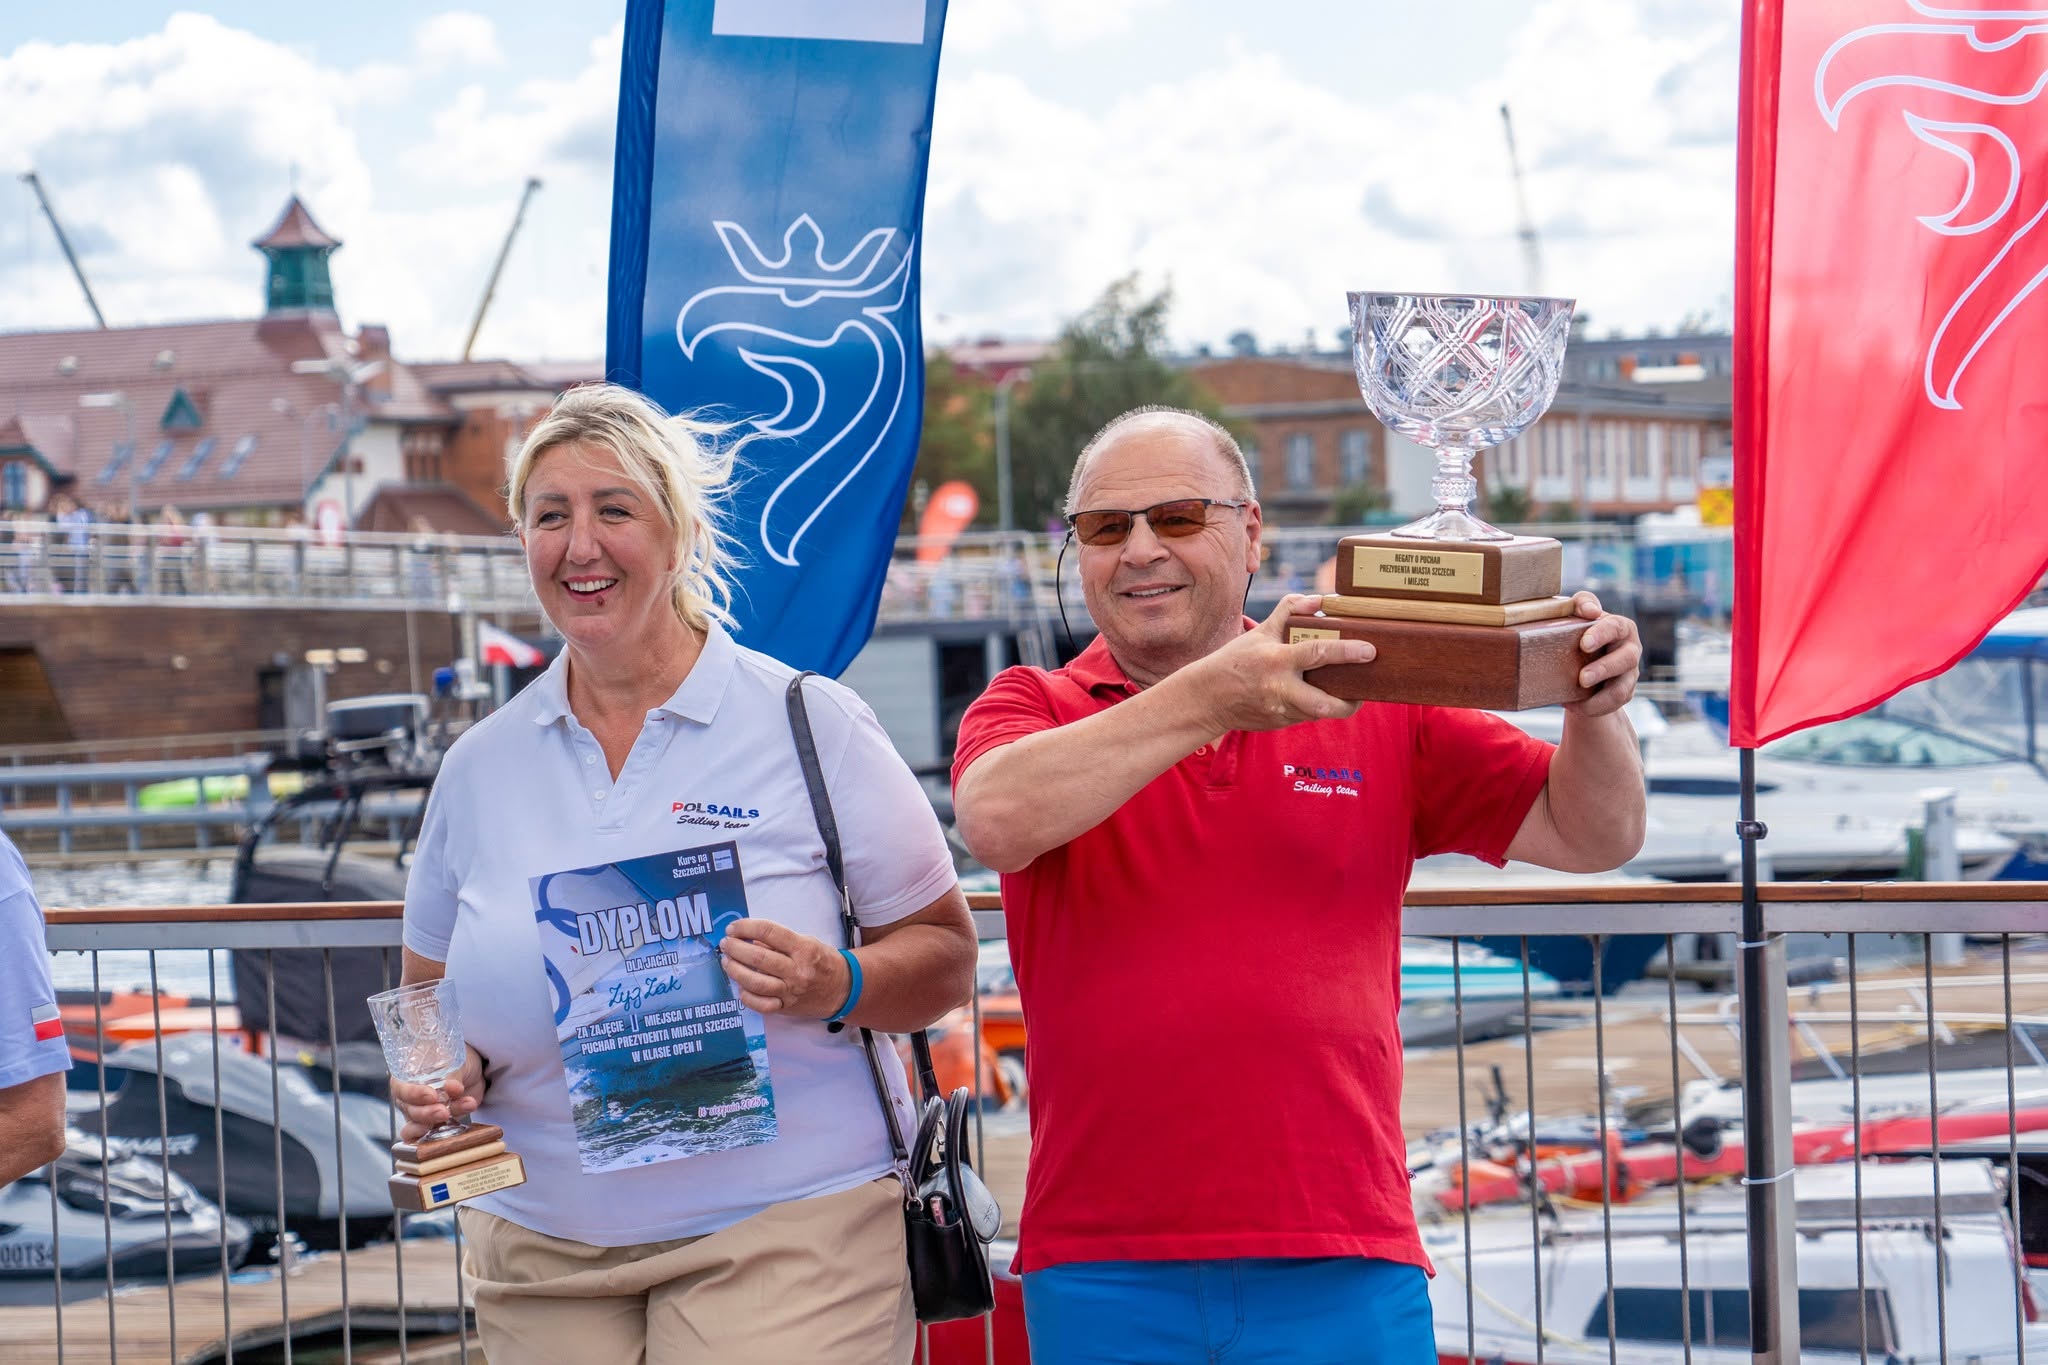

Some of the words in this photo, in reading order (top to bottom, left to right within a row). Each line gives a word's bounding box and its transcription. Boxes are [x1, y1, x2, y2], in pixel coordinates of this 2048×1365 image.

[1395, 553, 1414, 564] REGATY
[1415, 554, 1419, 564] O
[1420, 555, 1441, 565] PUCHAR
[1379, 564, 1411, 575] PREZYDENTA
[1411, 566, 1431, 576] MIASTA
[1432, 567, 1456, 577] SZCZECIN
[1408, 577, 1430, 587] MIEJSCE
[1283, 764, 1363, 782] POLSAILS
[1293, 780, 1333, 798] Sailing
[1336, 784, 1358, 797] team
[672, 802, 760, 819] POLSAILS
[677, 815, 720, 829] Sailing
[724, 821, 750, 829] team
[677, 854, 697, 866] Kurs
[698, 853, 708, 863] na
[672, 865, 706, 879] Szczecin
[576, 892, 713, 956] DYPLOM
[625, 957, 645, 973] DLA
[645, 951, 679, 970] JACHTU
[576, 1026, 589, 1039] ZA
[589, 1020, 625, 1038] ZAJĘCIE
[643, 1009, 683, 1027] MIEJSCA
[683, 1007, 693, 1020] W
[694, 999, 737, 1018] REGATACH
[581, 1038, 616, 1055] PUCHAR
[617, 1029, 669, 1049] PREZYDENTA
[671, 1022, 704, 1039] MIASTA
[704, 1015, 743, 1033] SZCZECIN
[631, 1050, 641, 1063] W
[643, 1045, 671, 1061] KLASIE
[672, 1041, 695, 1056] OPEN
[696, 1039, 703, 1052] II
